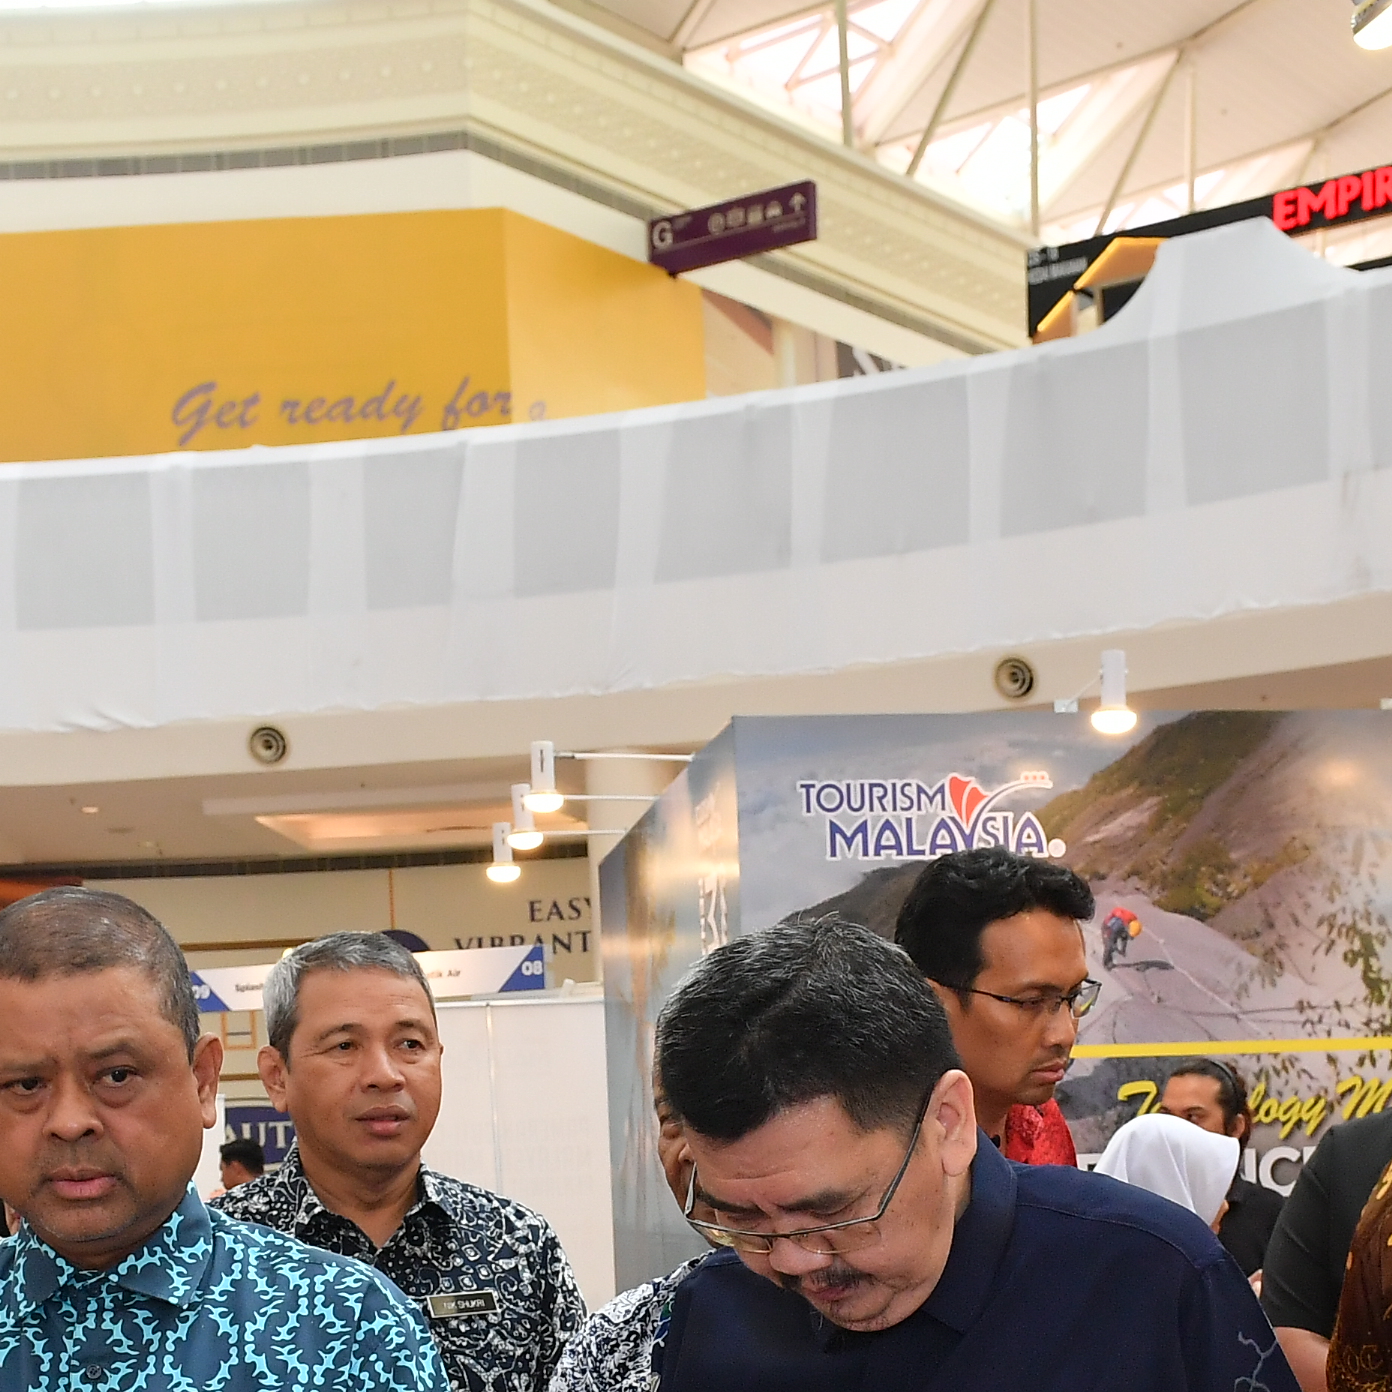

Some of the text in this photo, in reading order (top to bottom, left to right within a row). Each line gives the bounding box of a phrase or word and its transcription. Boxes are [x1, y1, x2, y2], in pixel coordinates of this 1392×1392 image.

[653, 222, 673, 248] G
[173, 376, 511, 447] Get ready for
[798, 780, 948, 816] TOURISM
[827, 811, 1049, 860] MALAYSIA
[521, 960, 543, 976] 08
